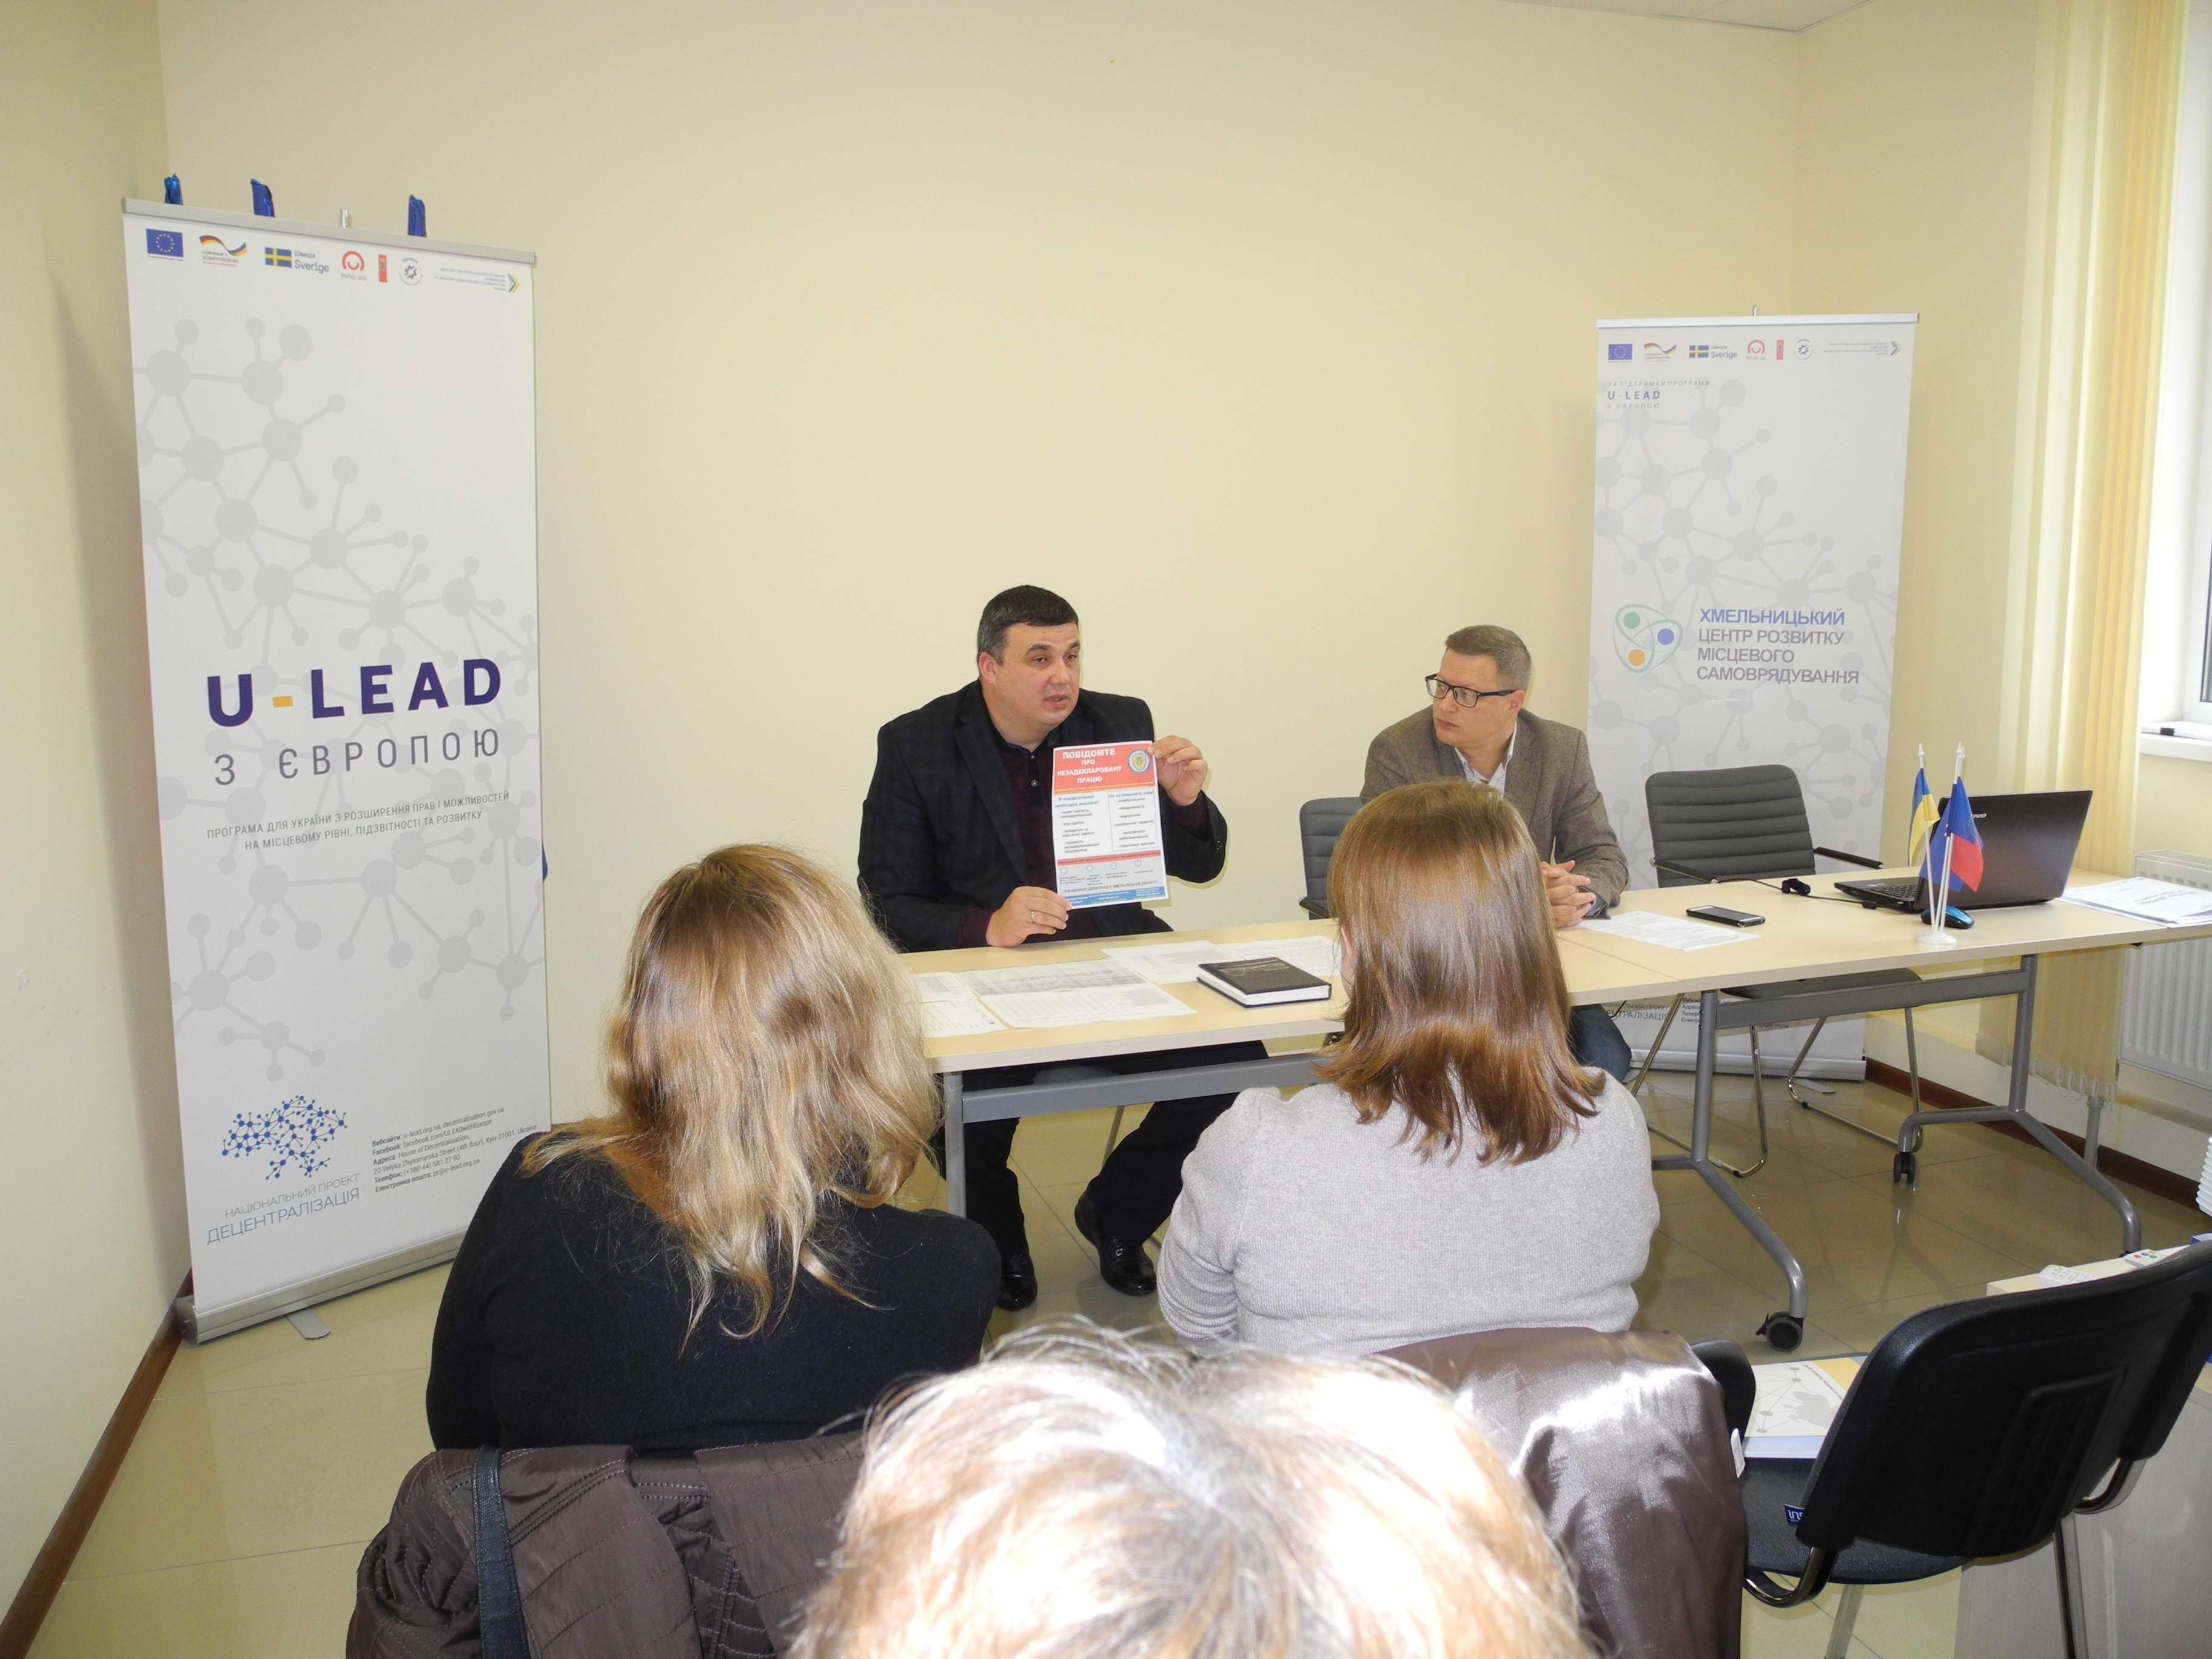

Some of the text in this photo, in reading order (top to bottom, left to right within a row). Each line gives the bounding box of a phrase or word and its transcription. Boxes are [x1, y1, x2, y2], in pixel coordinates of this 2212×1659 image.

[295, 260, 329, 273] Sverige
[1711, 351, 1738, 360] Sverige
[1699, 608, 1845, 627] ХМЕЛЬНИЦЬКИЙ
[1698, 629, 1845, 646] ЦЕНТР РОЗВИТКУ
[1698, 647, 1795, 663] МІСЦЕВОГО
[1697, 666, 1860, 685] САМОВРЯДУВАННЯ
[214, 728, 498, 785] З ЄВРОПОЮ
[1062, 748, 1116, 760] ПОВІДОМТЕ
[1057, 765, 1122, 776] НЕЗАДЕКЛАРОВАНУ
[207, 824, 264, 839] ПРОГРАМА
[267, 820, 288, 834] ДЛЯ
[291, 814, 332, 829] УКРАЇНИ
[335, 813, 341, 822] З
[344, 805, 410, 821] РОЗШИРЕННЯ
[412, 801, 435, 813] ПРАВ
[443, 790, 509, 808] МОЖЛИВОСТЕЙ
[245, 811, 482, 850] НА МІСЦЕВОМУ РІВНІ, ПІДЗВІТНОСТІ ТА РОЗВИТКУ
[398, 1149, 417, 1158] House
[403, 1152, 438, 1167] Zhytomyrska
[440, 1147, 455, 1156] Street
[517, 1125, 537, 1134] Ukraine
[403, 1166, 421, 1176] (+380
[375, 1178, 411, 1193] Електронна
[225, 1173, 360, 1219] НАЦІОНАЛЬНИЙ ПРОЕКТ
[207, 1187, 360, 1245] ДЕЦЕНТРАЛІЗАЦІЯ
